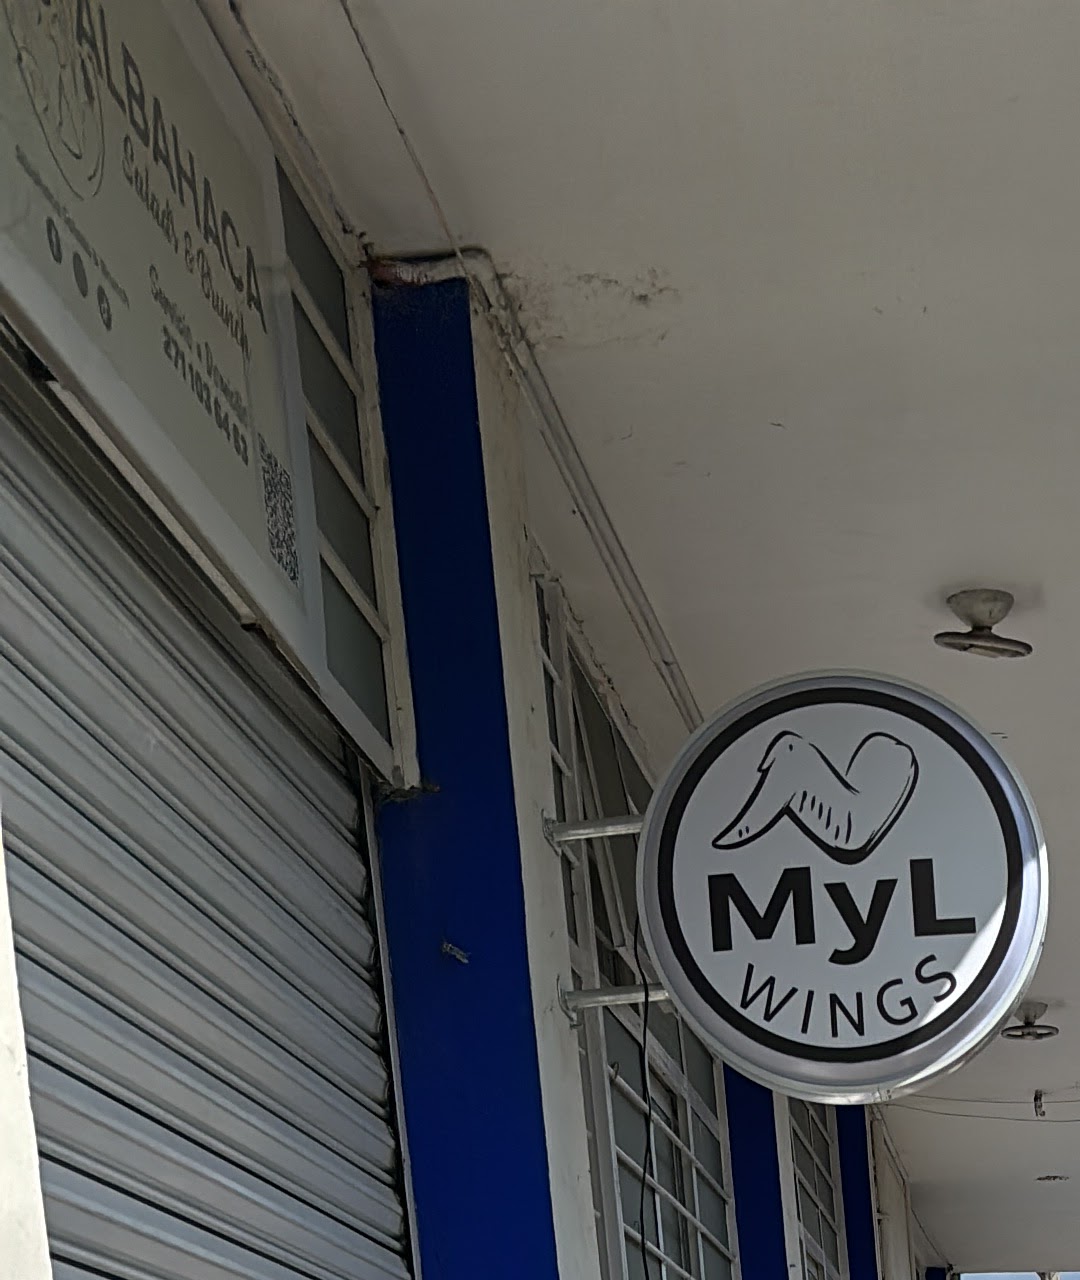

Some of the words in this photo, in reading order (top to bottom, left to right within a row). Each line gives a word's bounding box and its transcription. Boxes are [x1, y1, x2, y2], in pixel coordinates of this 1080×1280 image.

[76, 0, 267, 334] ALBAHACA
[707, 857, 977, 965] MyL
[739, 954, 957, 1038] WINGS
